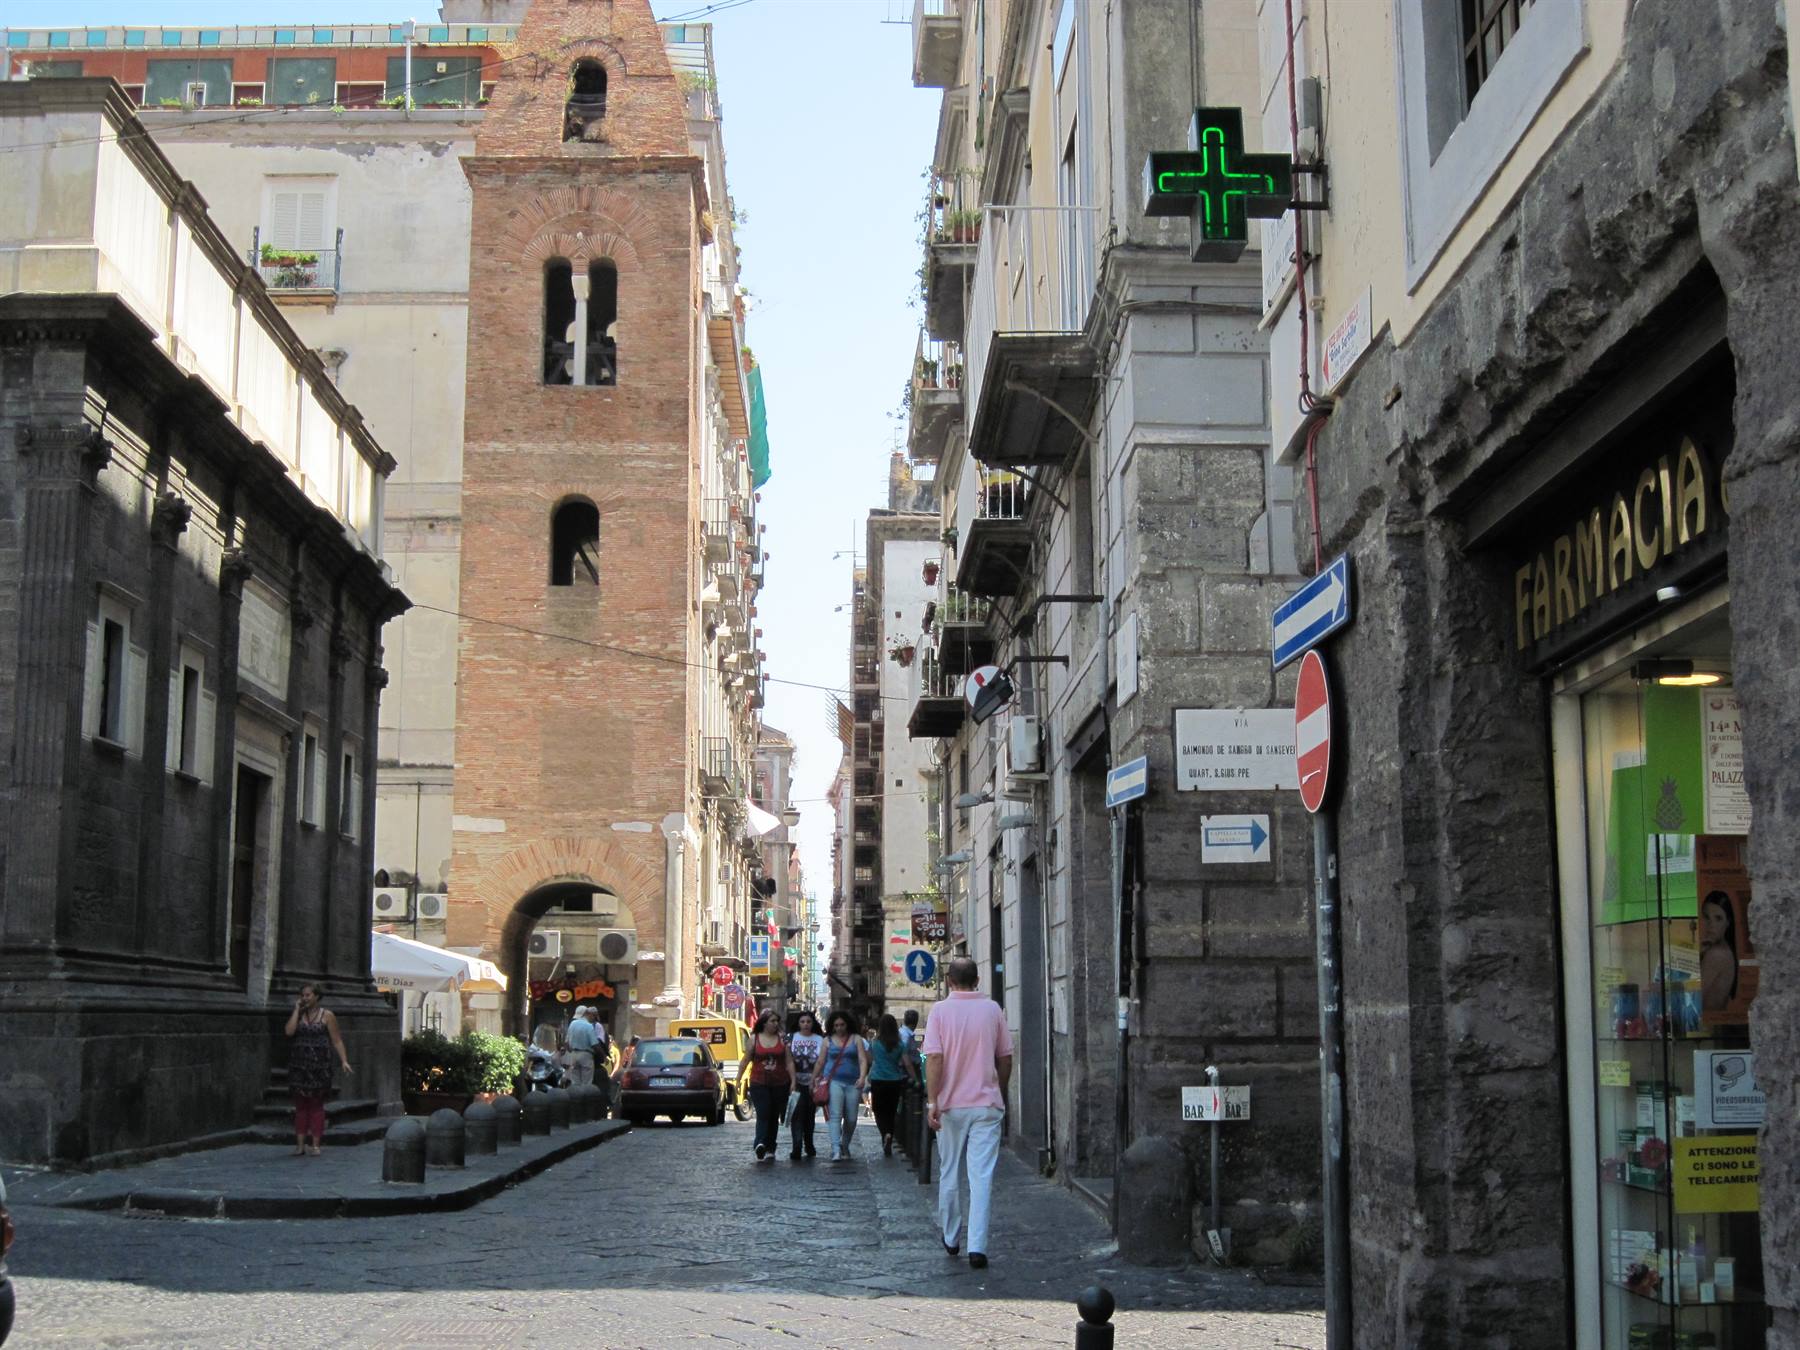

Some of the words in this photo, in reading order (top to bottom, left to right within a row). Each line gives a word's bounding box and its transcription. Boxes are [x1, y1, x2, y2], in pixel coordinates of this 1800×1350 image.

[1515, 435, 1706, 651] FARMACIA
[1234, 719, 1249, 728] VIA
[1182, 745, 1214, 755] RAIMONDO
[1217, 745, 1225, 755] DE
[1188, 768, 1212, 778] QUART.
[928, 928, 945, 937] 40
[1184, 1105, 1204, 1119] BAR
[1225, 1103, 1241, 1118] BAR
[1688, 1146, 1757, 1157] ATTENZIONE
[1693, 1162, 1704, 1171] CI
[1707, 1161, 1739, 1170] SONO
[1742, 1160, 1755, 1169] LE
